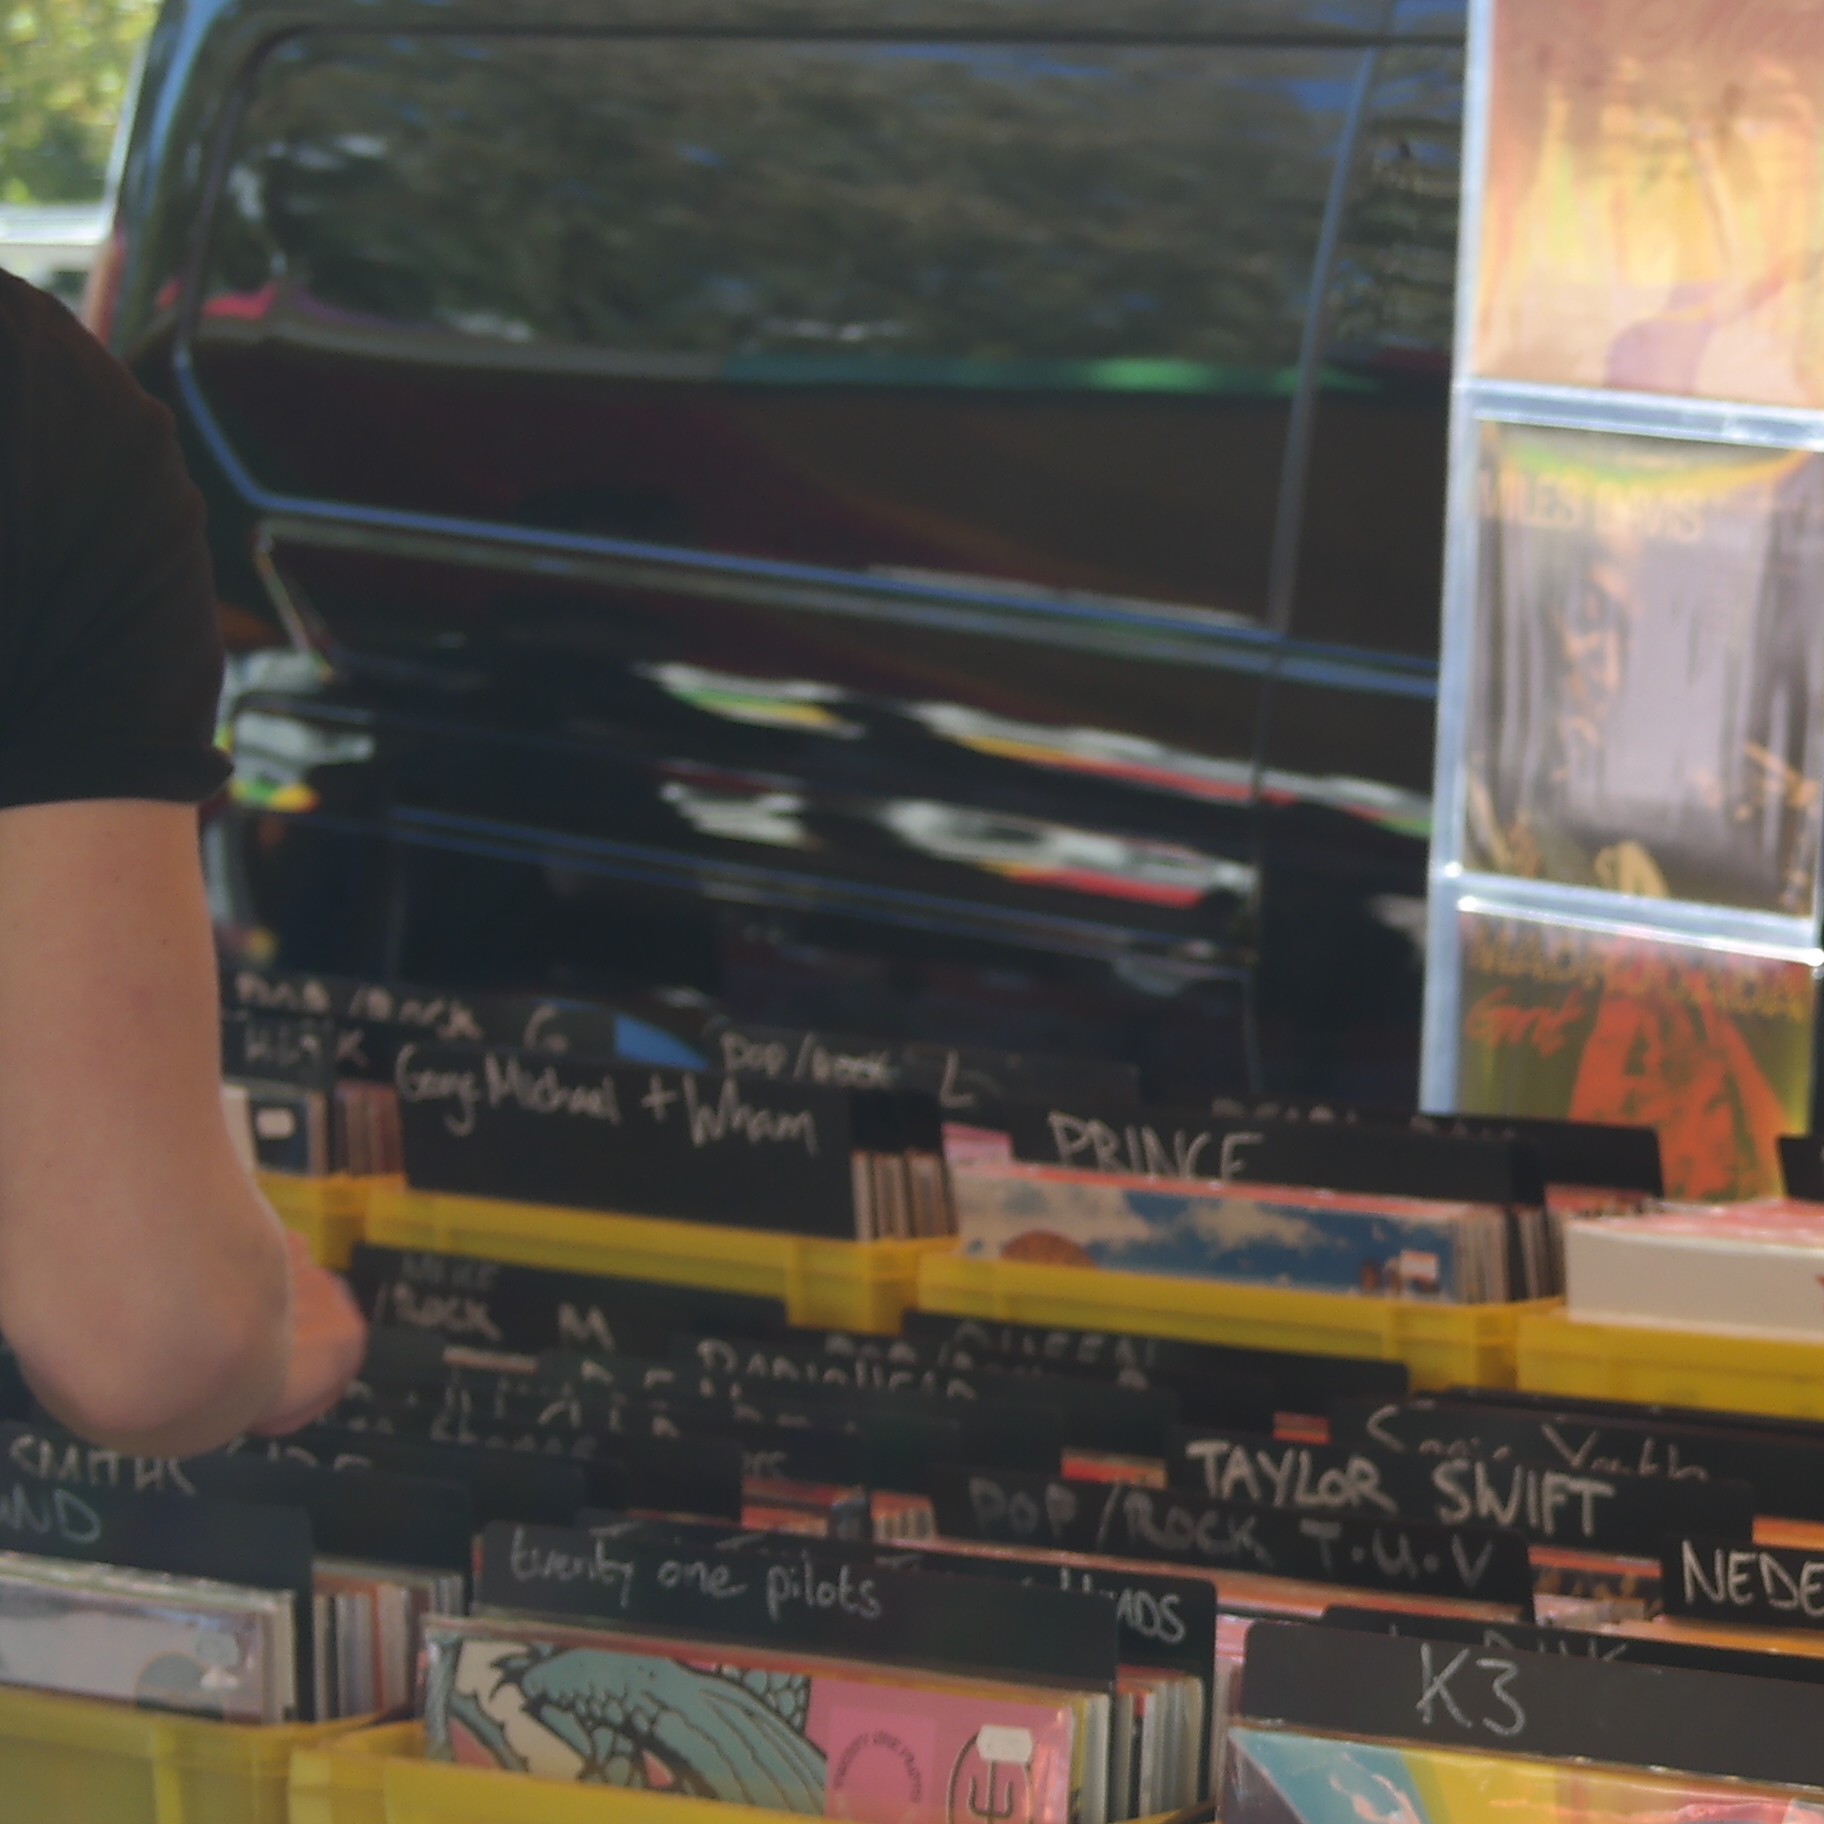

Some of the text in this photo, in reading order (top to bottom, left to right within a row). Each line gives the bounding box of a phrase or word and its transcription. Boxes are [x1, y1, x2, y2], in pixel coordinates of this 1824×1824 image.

[1049, 1110, 1264, 1183] PRINCE
[1186, 1440, 1615, 1537] TAYLOR SWIFT
[656, 1559, 749, 1599] one
[766, 1551, 884, 1623] pilots
[1417, 1642, 1529, 1737] K3
